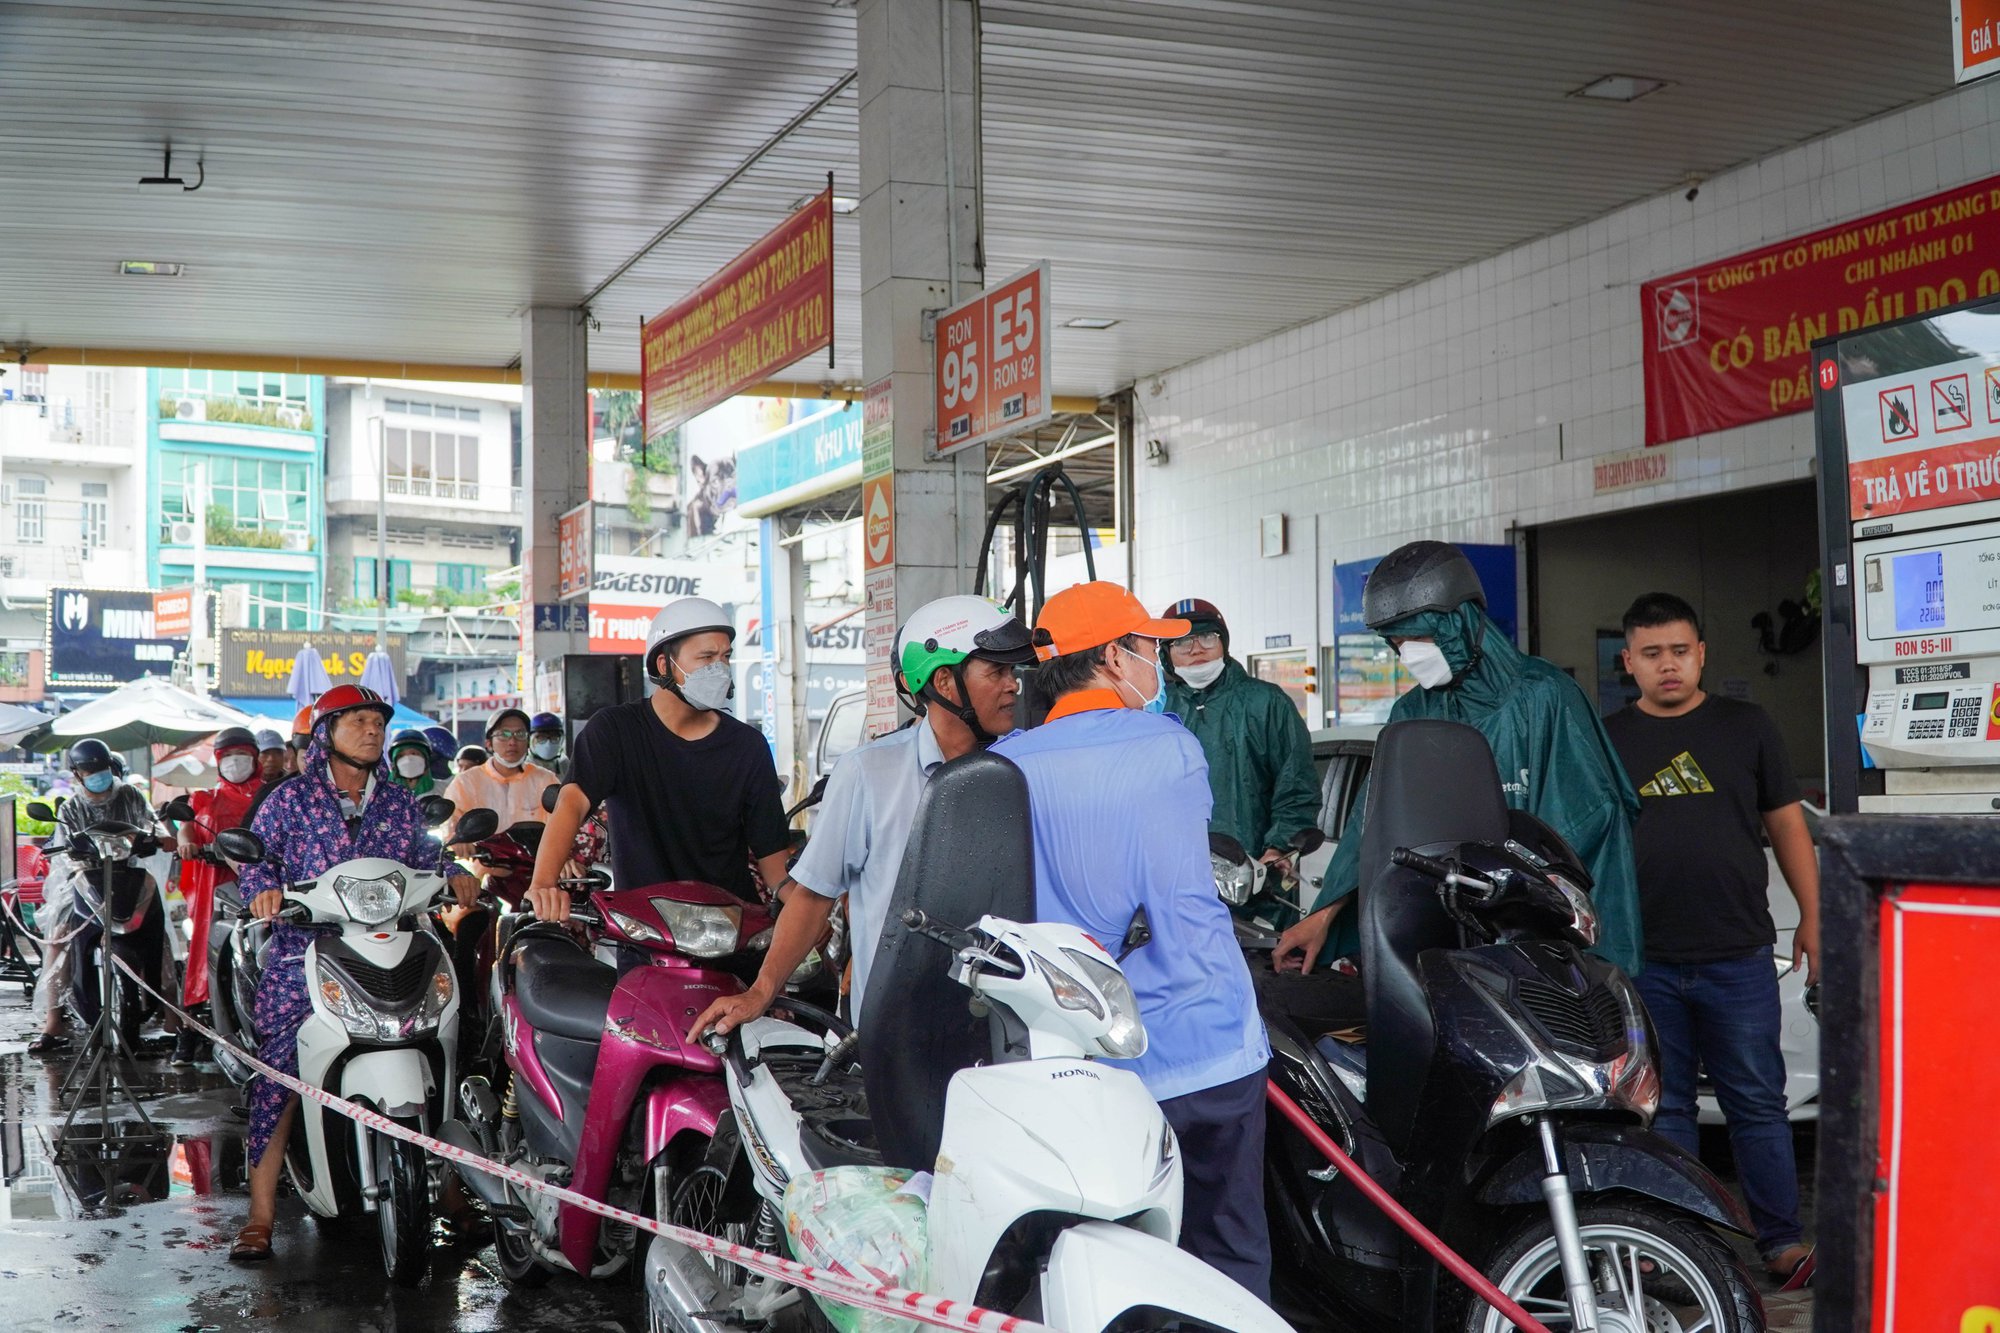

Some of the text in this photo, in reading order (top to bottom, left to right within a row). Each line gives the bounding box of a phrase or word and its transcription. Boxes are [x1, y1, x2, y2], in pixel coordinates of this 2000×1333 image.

[1971, 19, 1993, 54] GIÁ
[803, 217, 827, 272] DÂN
[1845, 232, 1973, 284] CHI NHÁNH 01
[1708, 266, 1755, 293] CÔNG
[1759, 254, 1777, 277] TY
[762, 305, 793, 366] CHÁY
[797, 294, 823, 346] 4/10
[948, 316, 972, 348] RON
[993, 287, 1034, 364] E5
[1710, 326, 1754, 373] CÓ
[1763, 312, 1827, 362] BÁN
[943, 341, 979, 410] 95
[994, 354, 1035, 391] RON 92
[1821, 366, 1835, 384] 11
[815, 427, 842, 465] KHU
[1863, 466, 1901, 505] TRẢ
[1905, 459, 1931, 498] VỀ
[560, 540, 573, 575] 95
[134, 644, 174, 661] HAIR
[1895, 637, 1952, 656] RON 95-III
[1902, 668, 1919, 676] TCCS
[1902, 675, 1919, 683] TCCS
[683, 983, 721, 992] HONDA
[1051, 1067, 1101, 1081] HONDA
